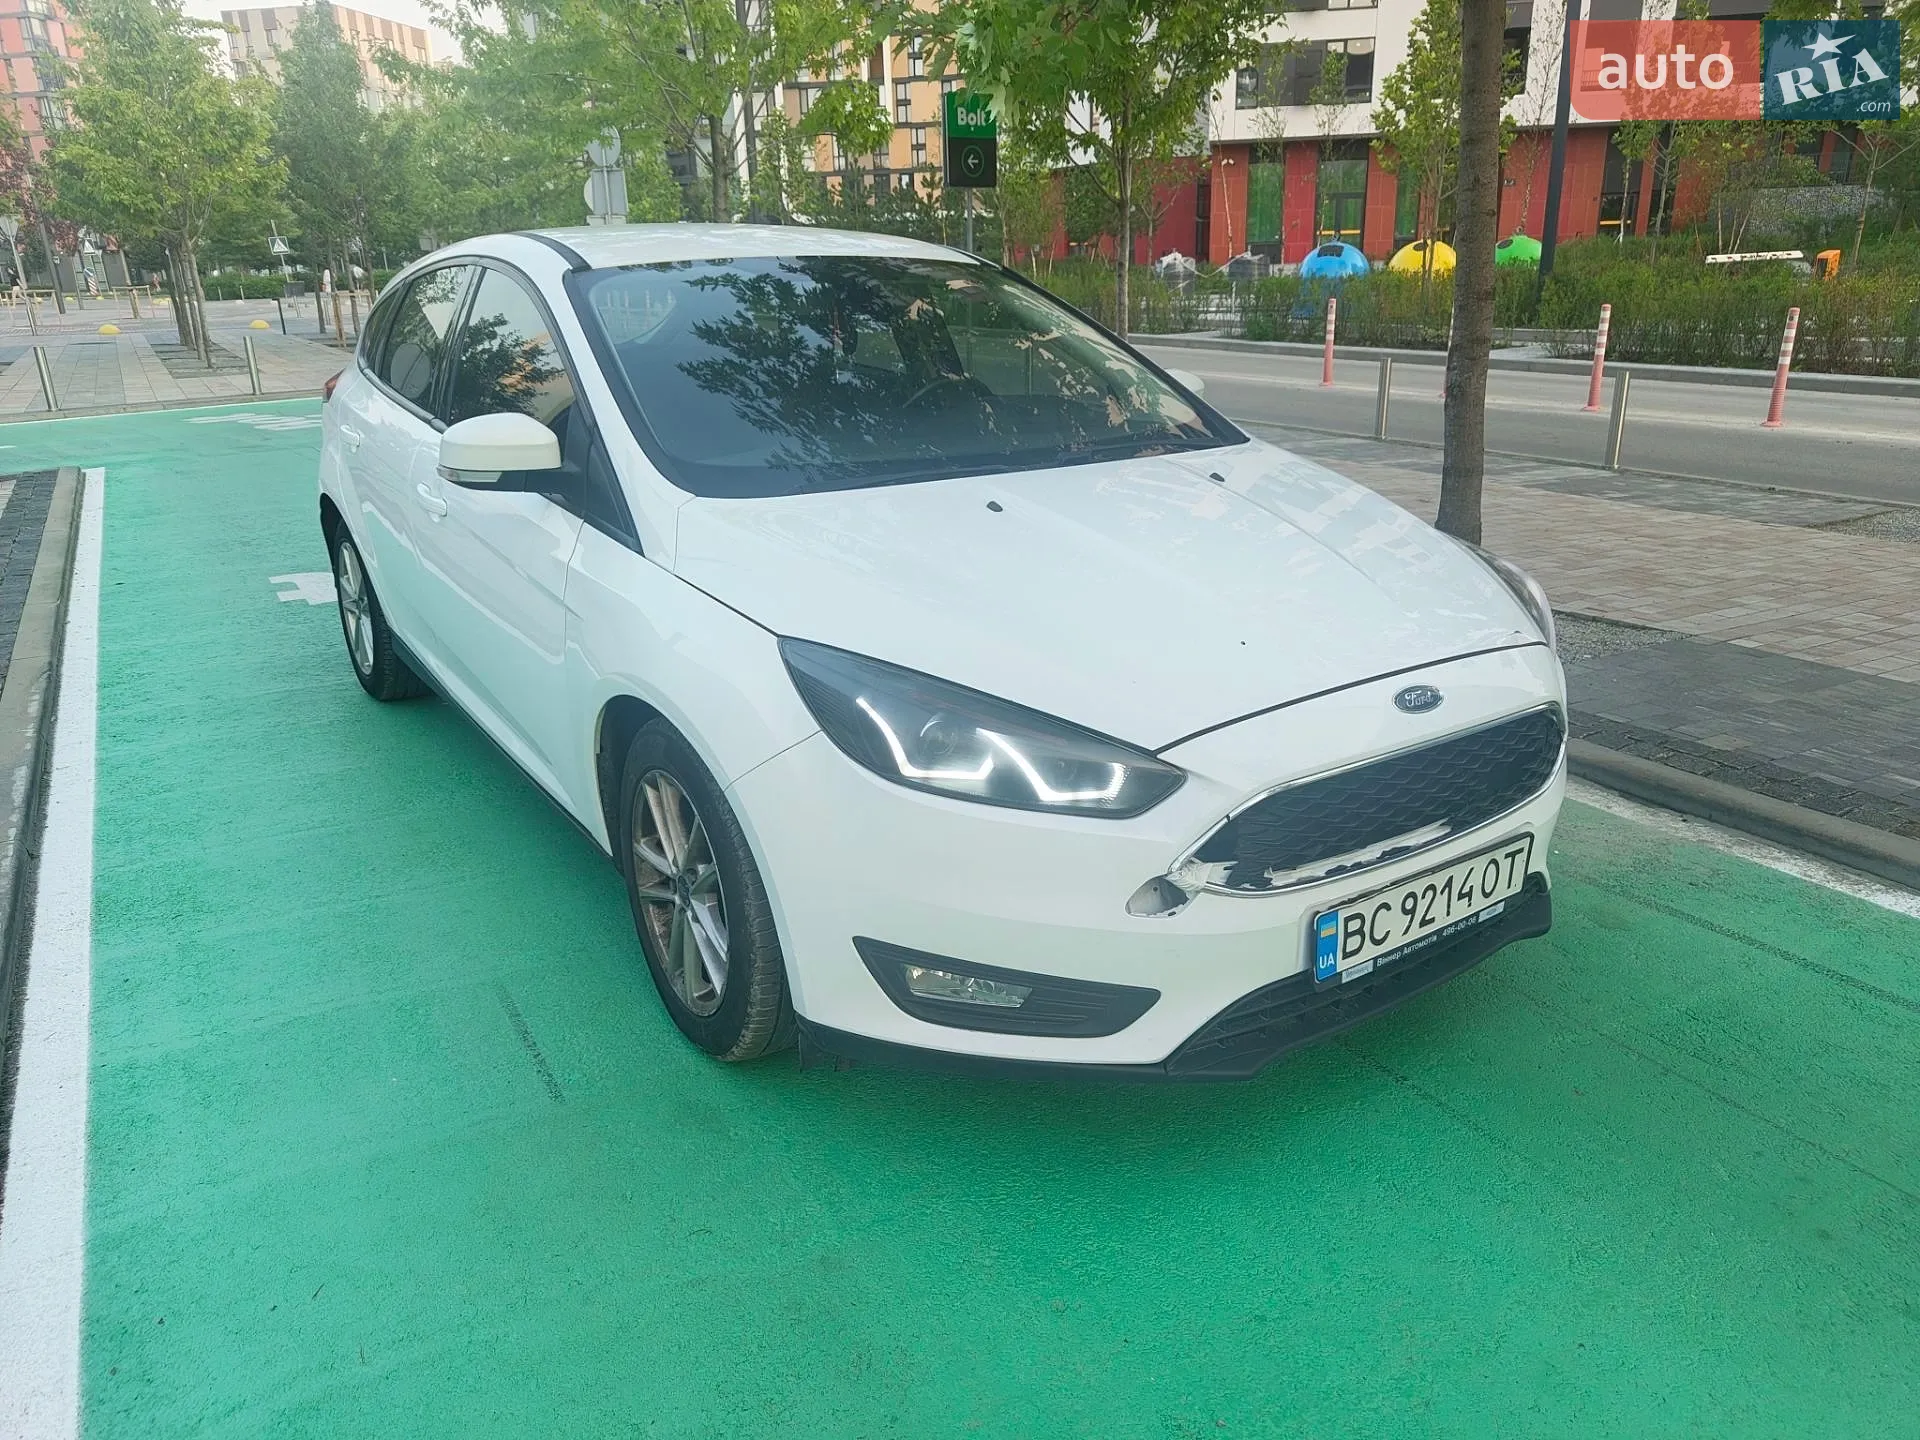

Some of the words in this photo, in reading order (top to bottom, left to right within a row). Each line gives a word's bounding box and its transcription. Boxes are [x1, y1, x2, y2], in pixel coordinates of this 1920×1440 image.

[957, 107, 986, 126] Bolt
[1405, 690, 1434, 707] Ford
[1342, 902, 1391, 960] BC
[1319, 952, 1335, 969] UA
